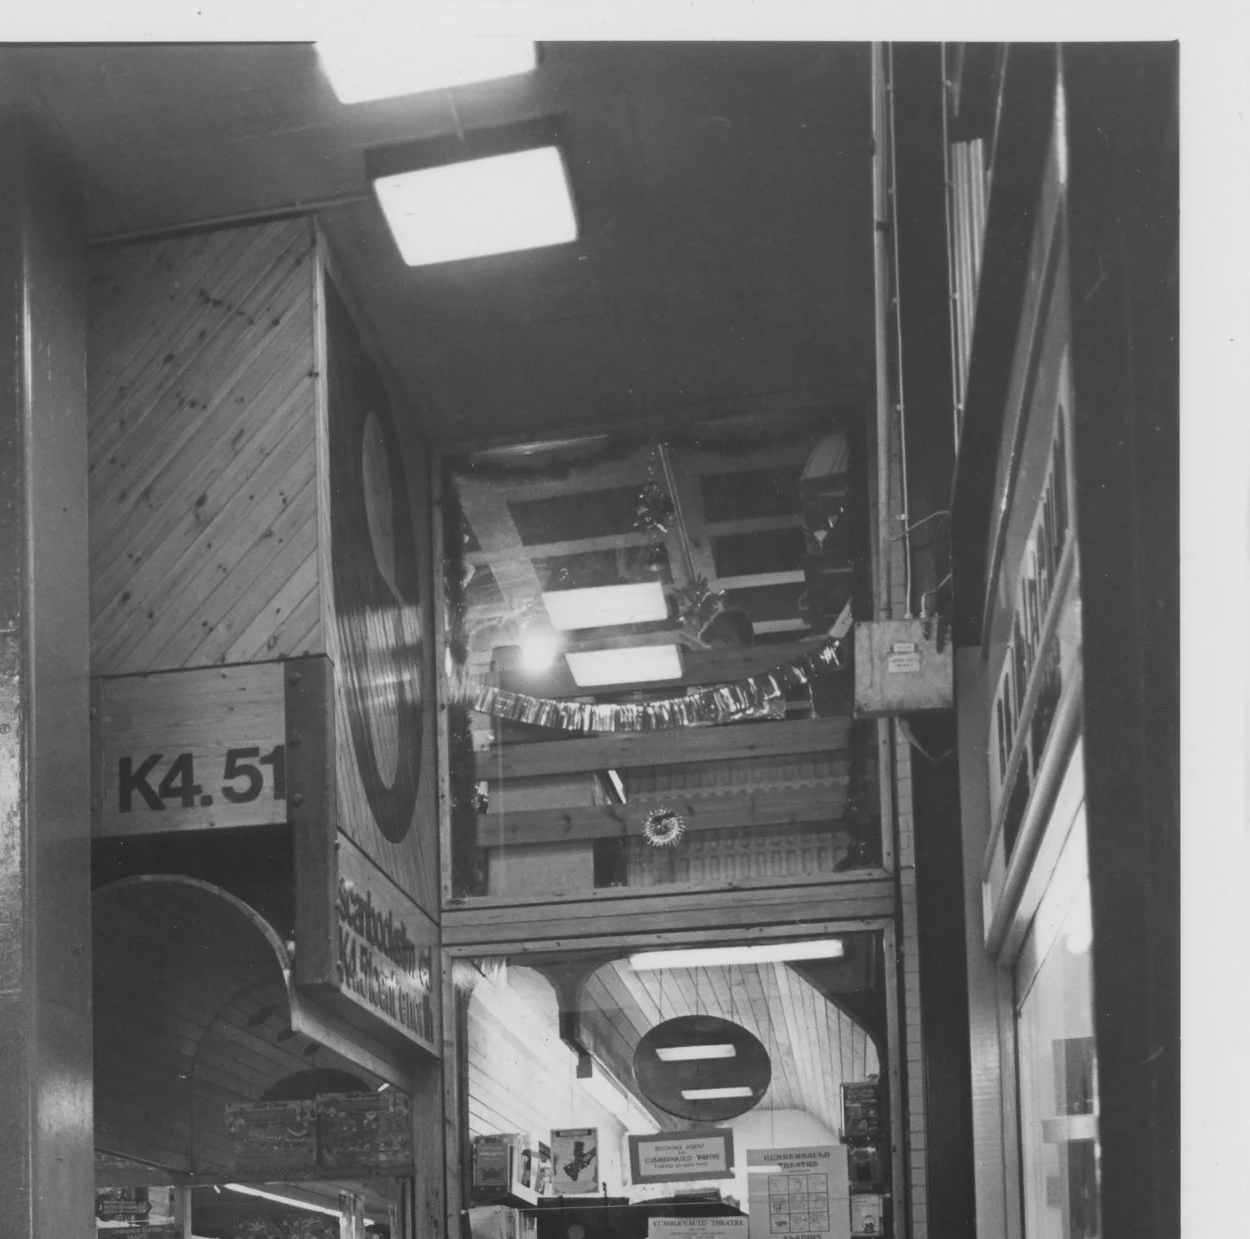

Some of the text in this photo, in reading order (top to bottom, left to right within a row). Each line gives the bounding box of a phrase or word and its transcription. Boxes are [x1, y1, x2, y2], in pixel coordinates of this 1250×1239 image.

[118, 744, 287, 813] K4.51
[763, 1151, 831, 1161] CUMBERNAULD
[777, 1160, 819, 1169] THEATRE
[653, 1219, 708, 1227] CUMBERNAULD
